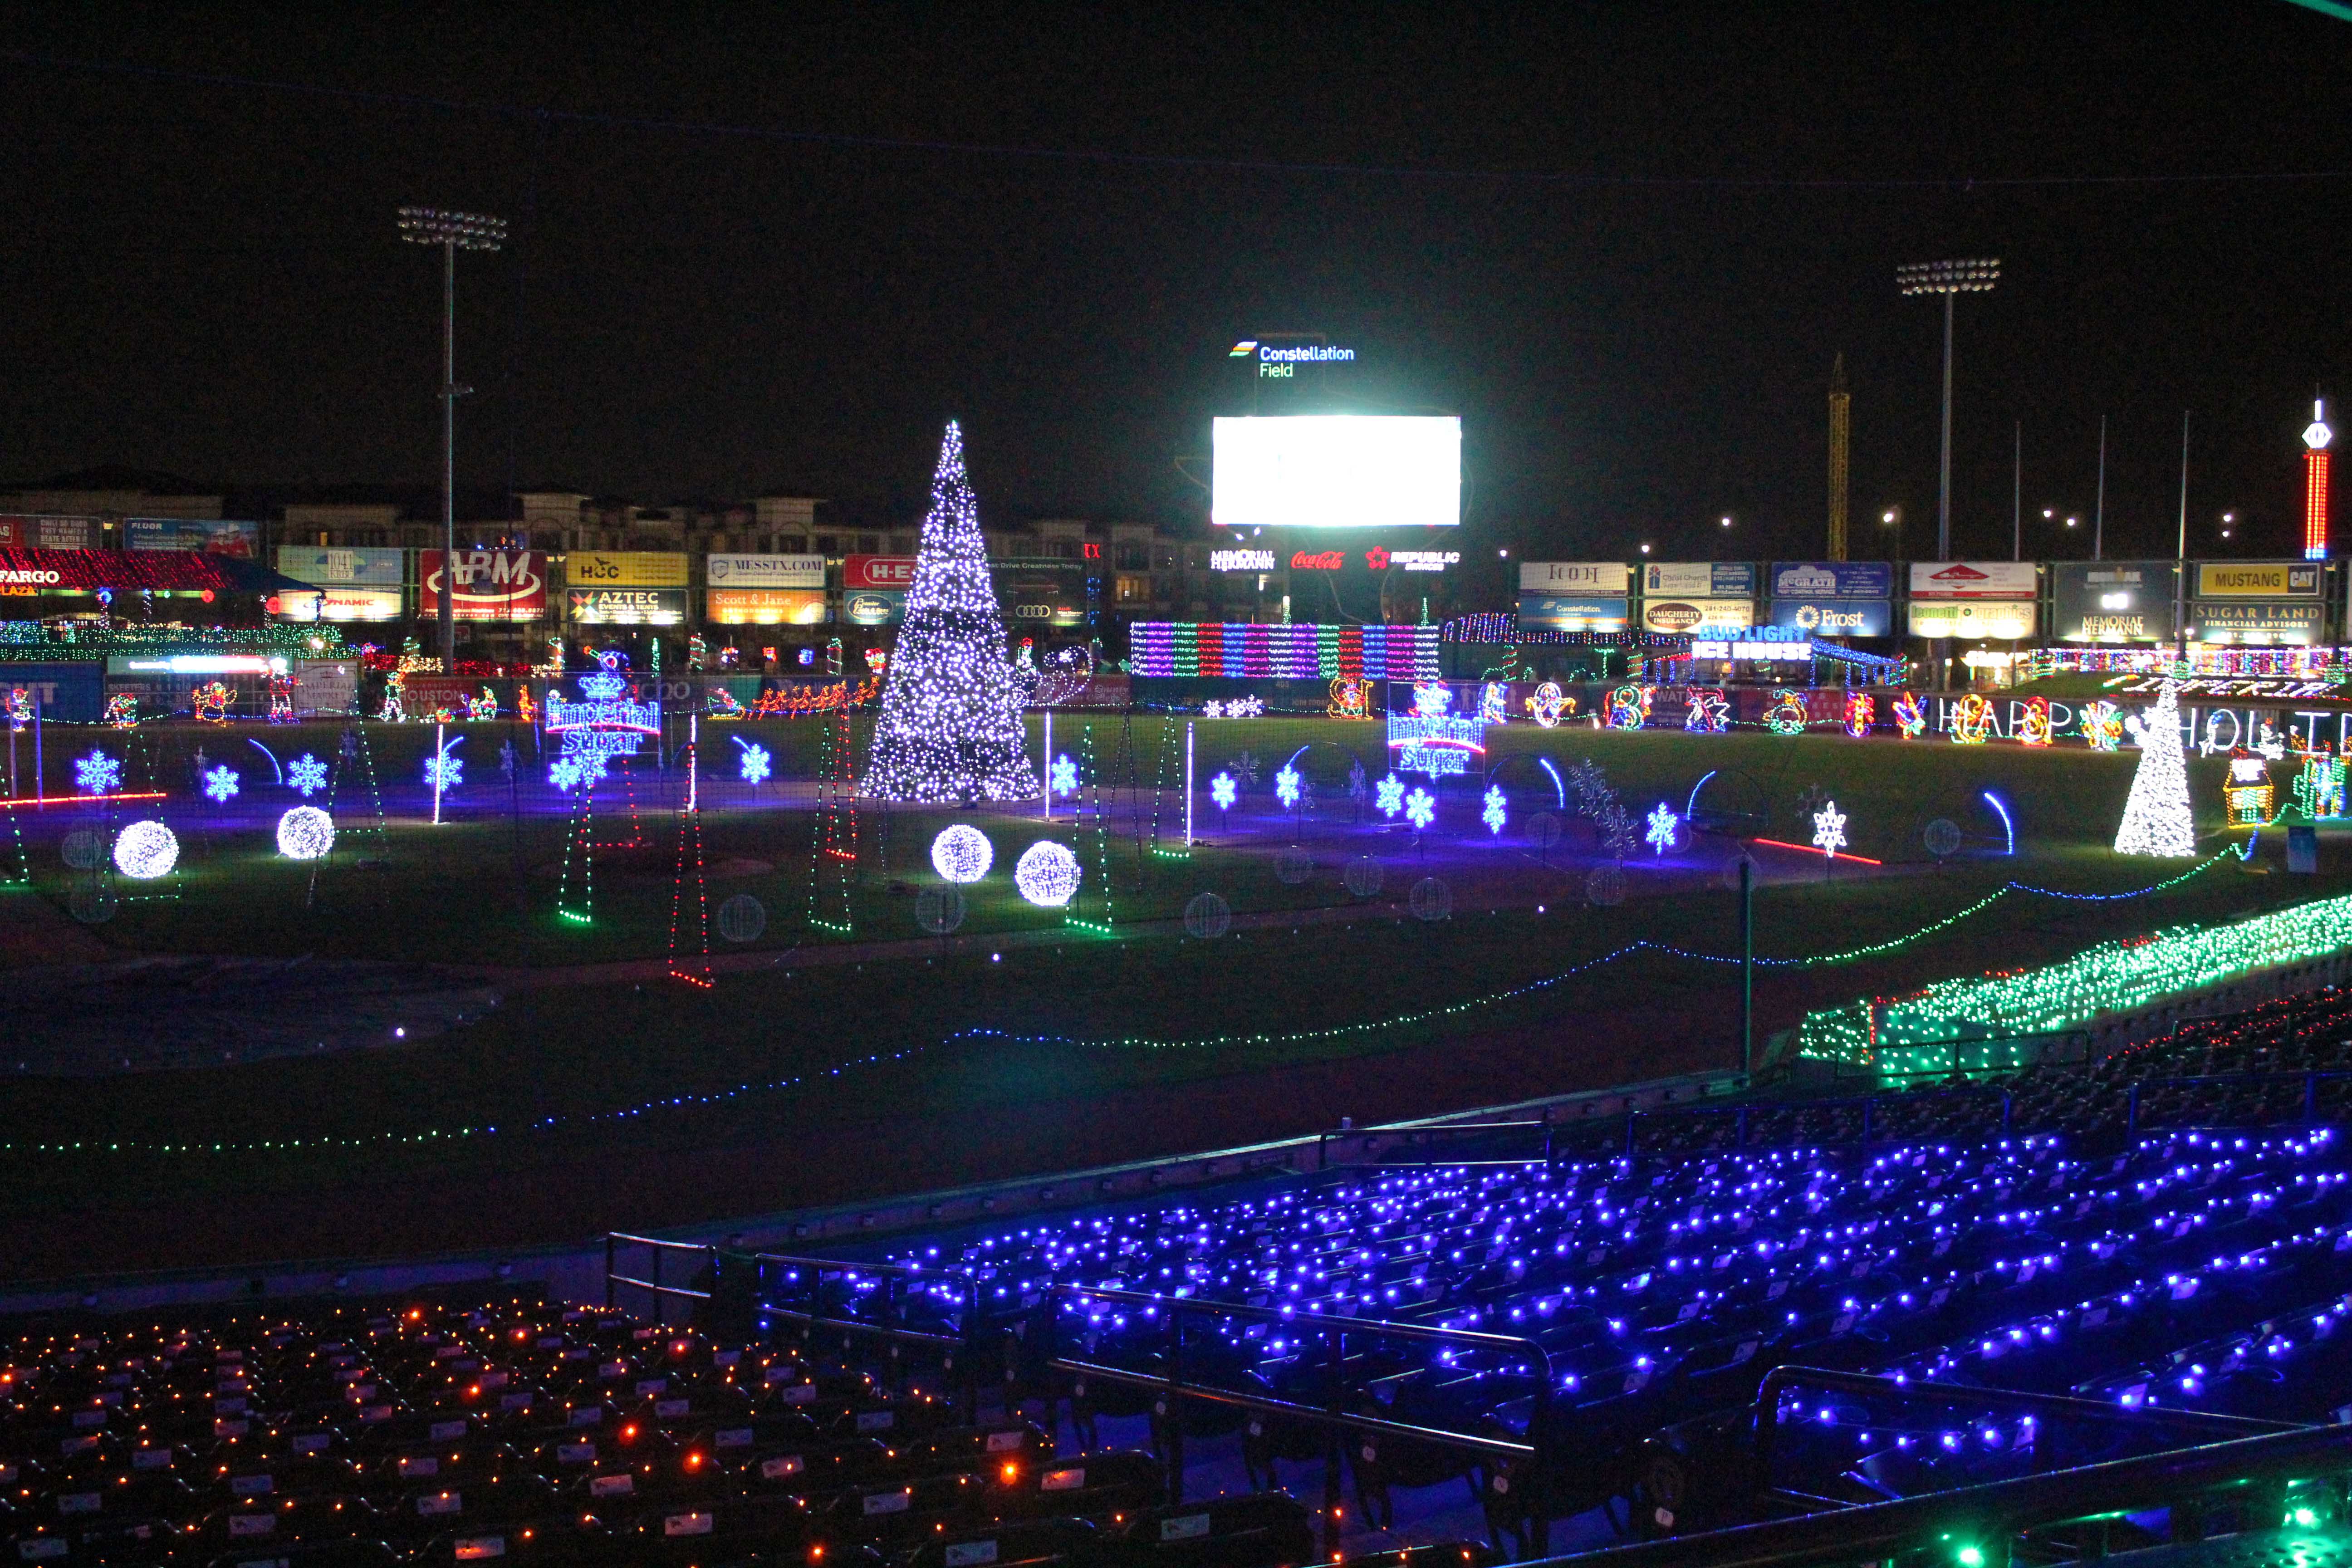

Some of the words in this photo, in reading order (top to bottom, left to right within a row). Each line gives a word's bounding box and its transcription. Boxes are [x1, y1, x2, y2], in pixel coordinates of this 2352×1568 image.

[1260, 346, 1354, 361] Constellation
[1260, 363, 1293, 377] Field
[1211, 550, 1274, 560] MEMORIAL
[1390, 550, 1460, 563] REPUBLIC
[442, 551, 531, 585] ABM
[581, 565, 619, 578] HCC
[735, 560, 822, 570] MESSTX.COM
[872, 564, 910, 578] H-E
[1210, 559, 1275, 571] HERMANN
[0, 570, 59, 583] FARGO
[2215, 573, 2280, 587] MUSTANG
[2290, 571, 2315, 587] CAT
[0, 586, 38, 596] LAZA
[598, 592, 659, 603] AZTEC
[715, 593, 746, 604] Scott
[750, 593, 759, 605] &
[762, 593, 791, 605] Jane
[1821, 609, 1865, 627] Frost
[2197, 607, 2258, 618] SUGAR
[2267, 606, 2319, 618] LAND
[2082, 616, 2144, 626] MEMORIAL
[2260, 620, 2309, 628] ADVISORS
[1698, 625, 1741, 641] BUD
[1744, 625, 1808, 642] LIGHT
[2082, 624, 2144, 636] HERMANN
[1692, 641, 1729, 659] ICE
[1732, 642, 1812, 661] HOUSE
[108, 683, 151, 691] SKEETERS
[401, 690, 464, 701] HOUSTON
[546, 700, 659, 728] Imperial
[1387, 714, 1483, 746] Imperial
[561, 728, 645, 757] Sugar
[1400, 745, 1470, 778] Sugar
